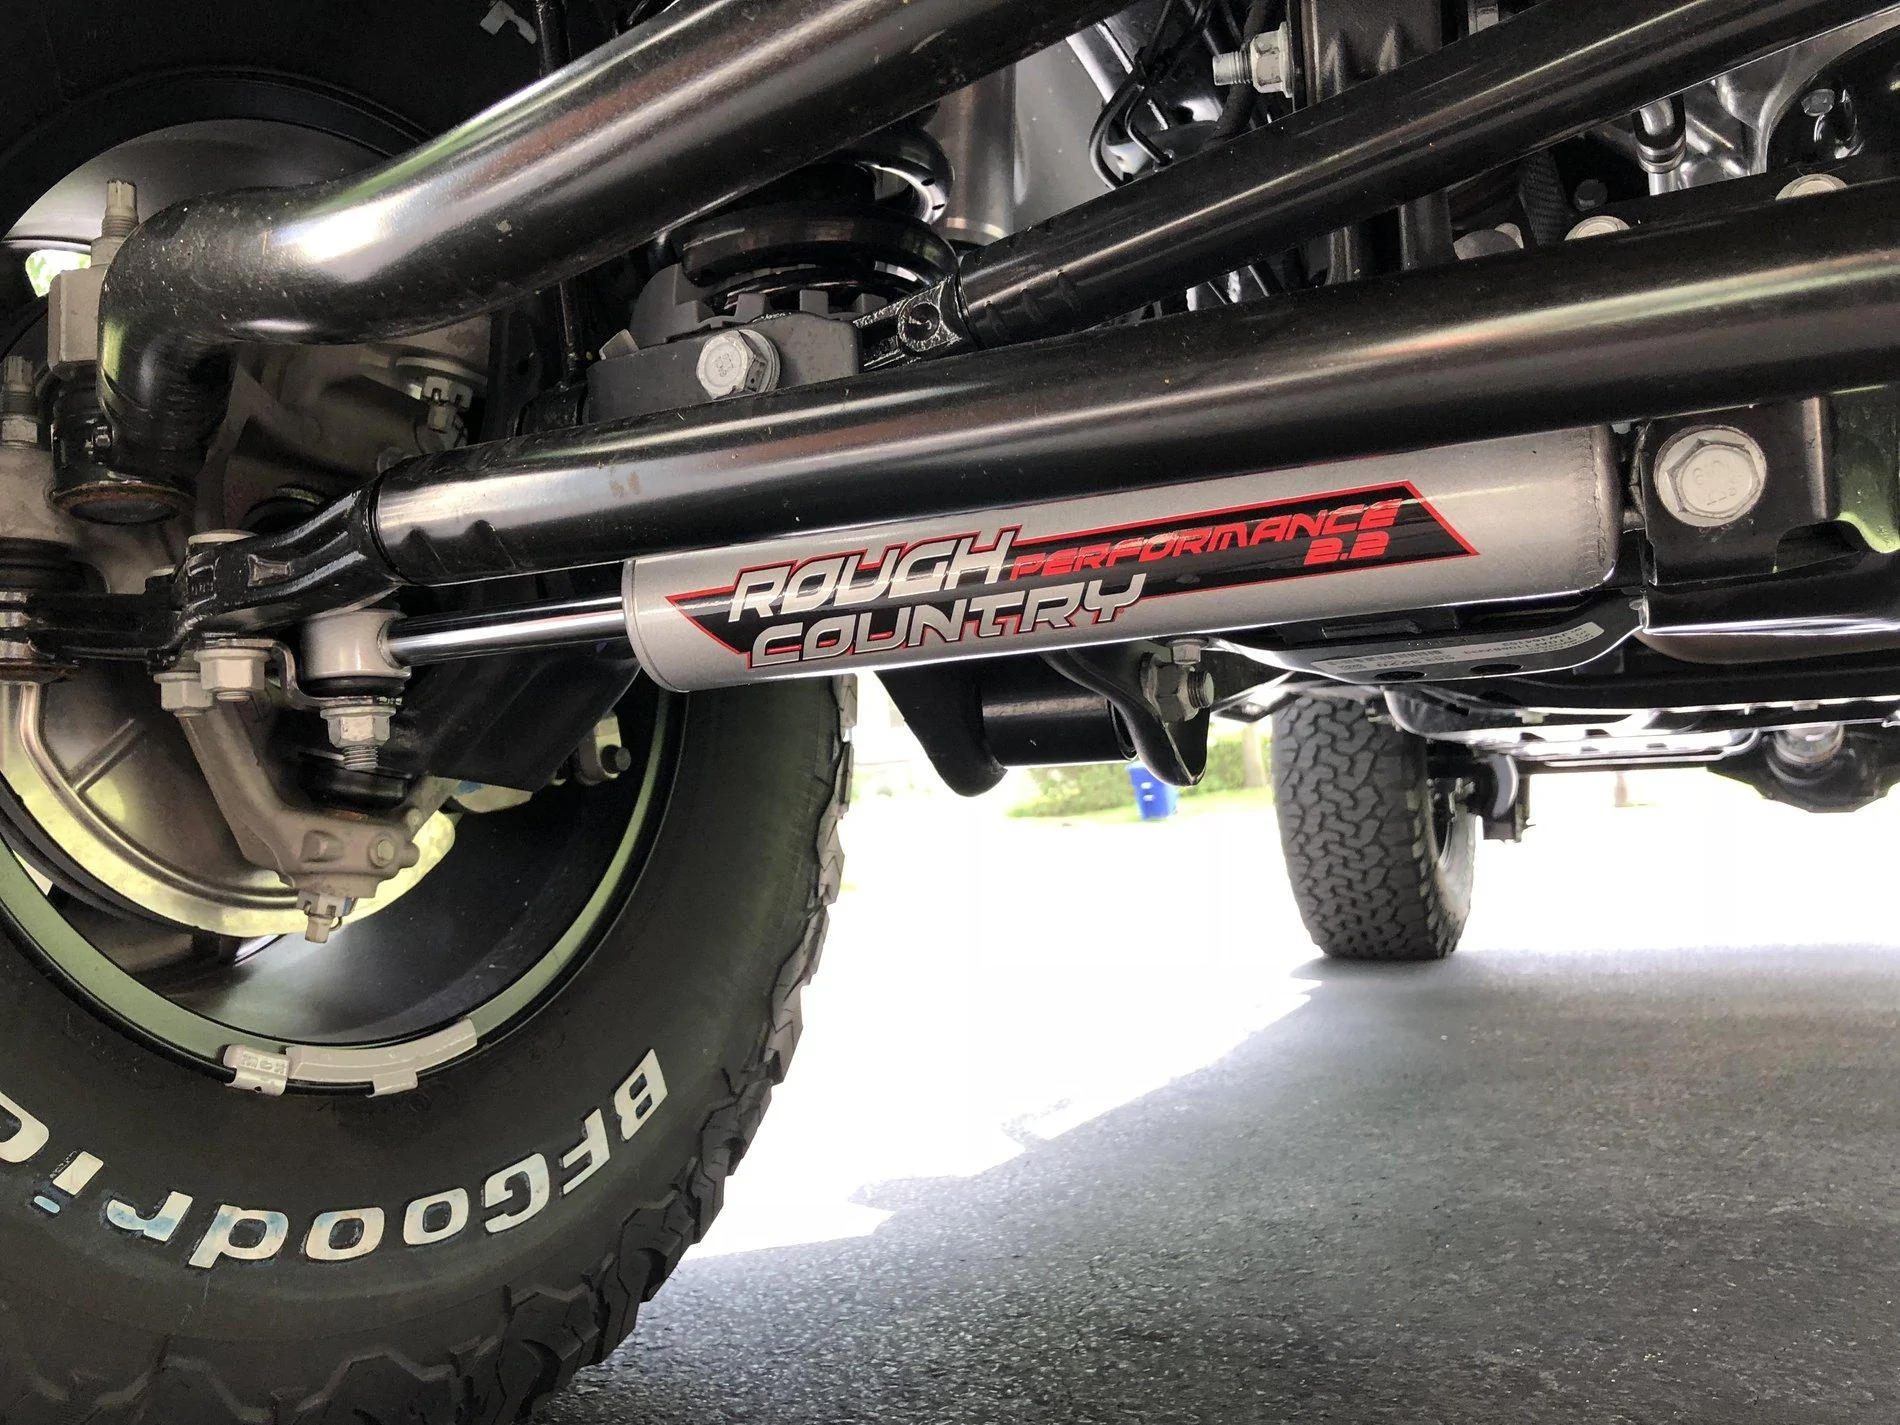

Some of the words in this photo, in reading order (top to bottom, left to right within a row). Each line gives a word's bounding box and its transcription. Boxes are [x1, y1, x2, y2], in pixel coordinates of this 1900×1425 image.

[727, 527, 1018, 623] ROUGH
[1009, 499, 1409, 582] PERFORMANCE
[1302, 530, 1391, 566] 2.2
[751, 573, 1148, 668] COUNTRY
